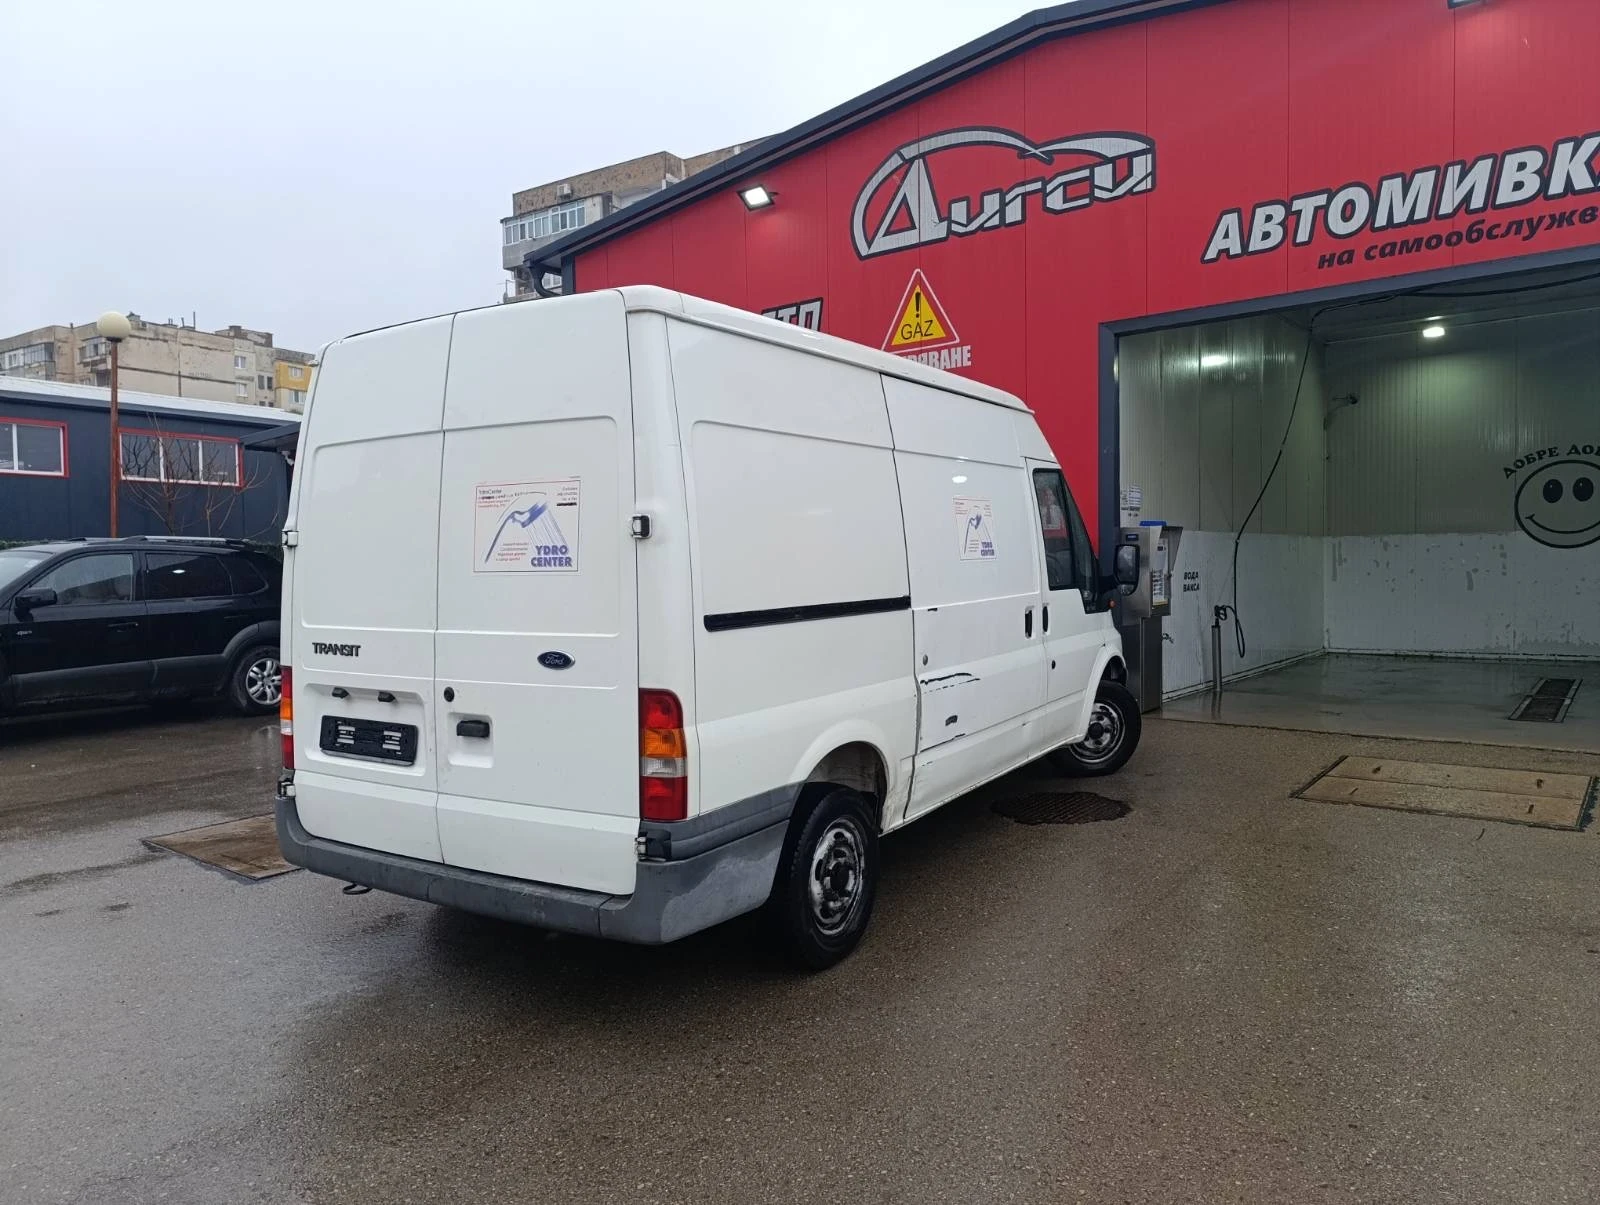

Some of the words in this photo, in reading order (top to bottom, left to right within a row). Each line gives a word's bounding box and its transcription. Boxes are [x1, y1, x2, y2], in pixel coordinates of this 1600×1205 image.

[1202, 133, 1600, 263] АВТОМИВК
[1318, 248, 1354, 269] на
[1364, 205, 1600, 260] самообслужв
[901, 319, 934, 341] GAZ
[1503, 446, 1559, 479] ДОБРЕ
[535, 545, 568, 556] YDRO
[531, 556, 572, 568] CENTER
[312, 642, 361, 657] TRANSIT
